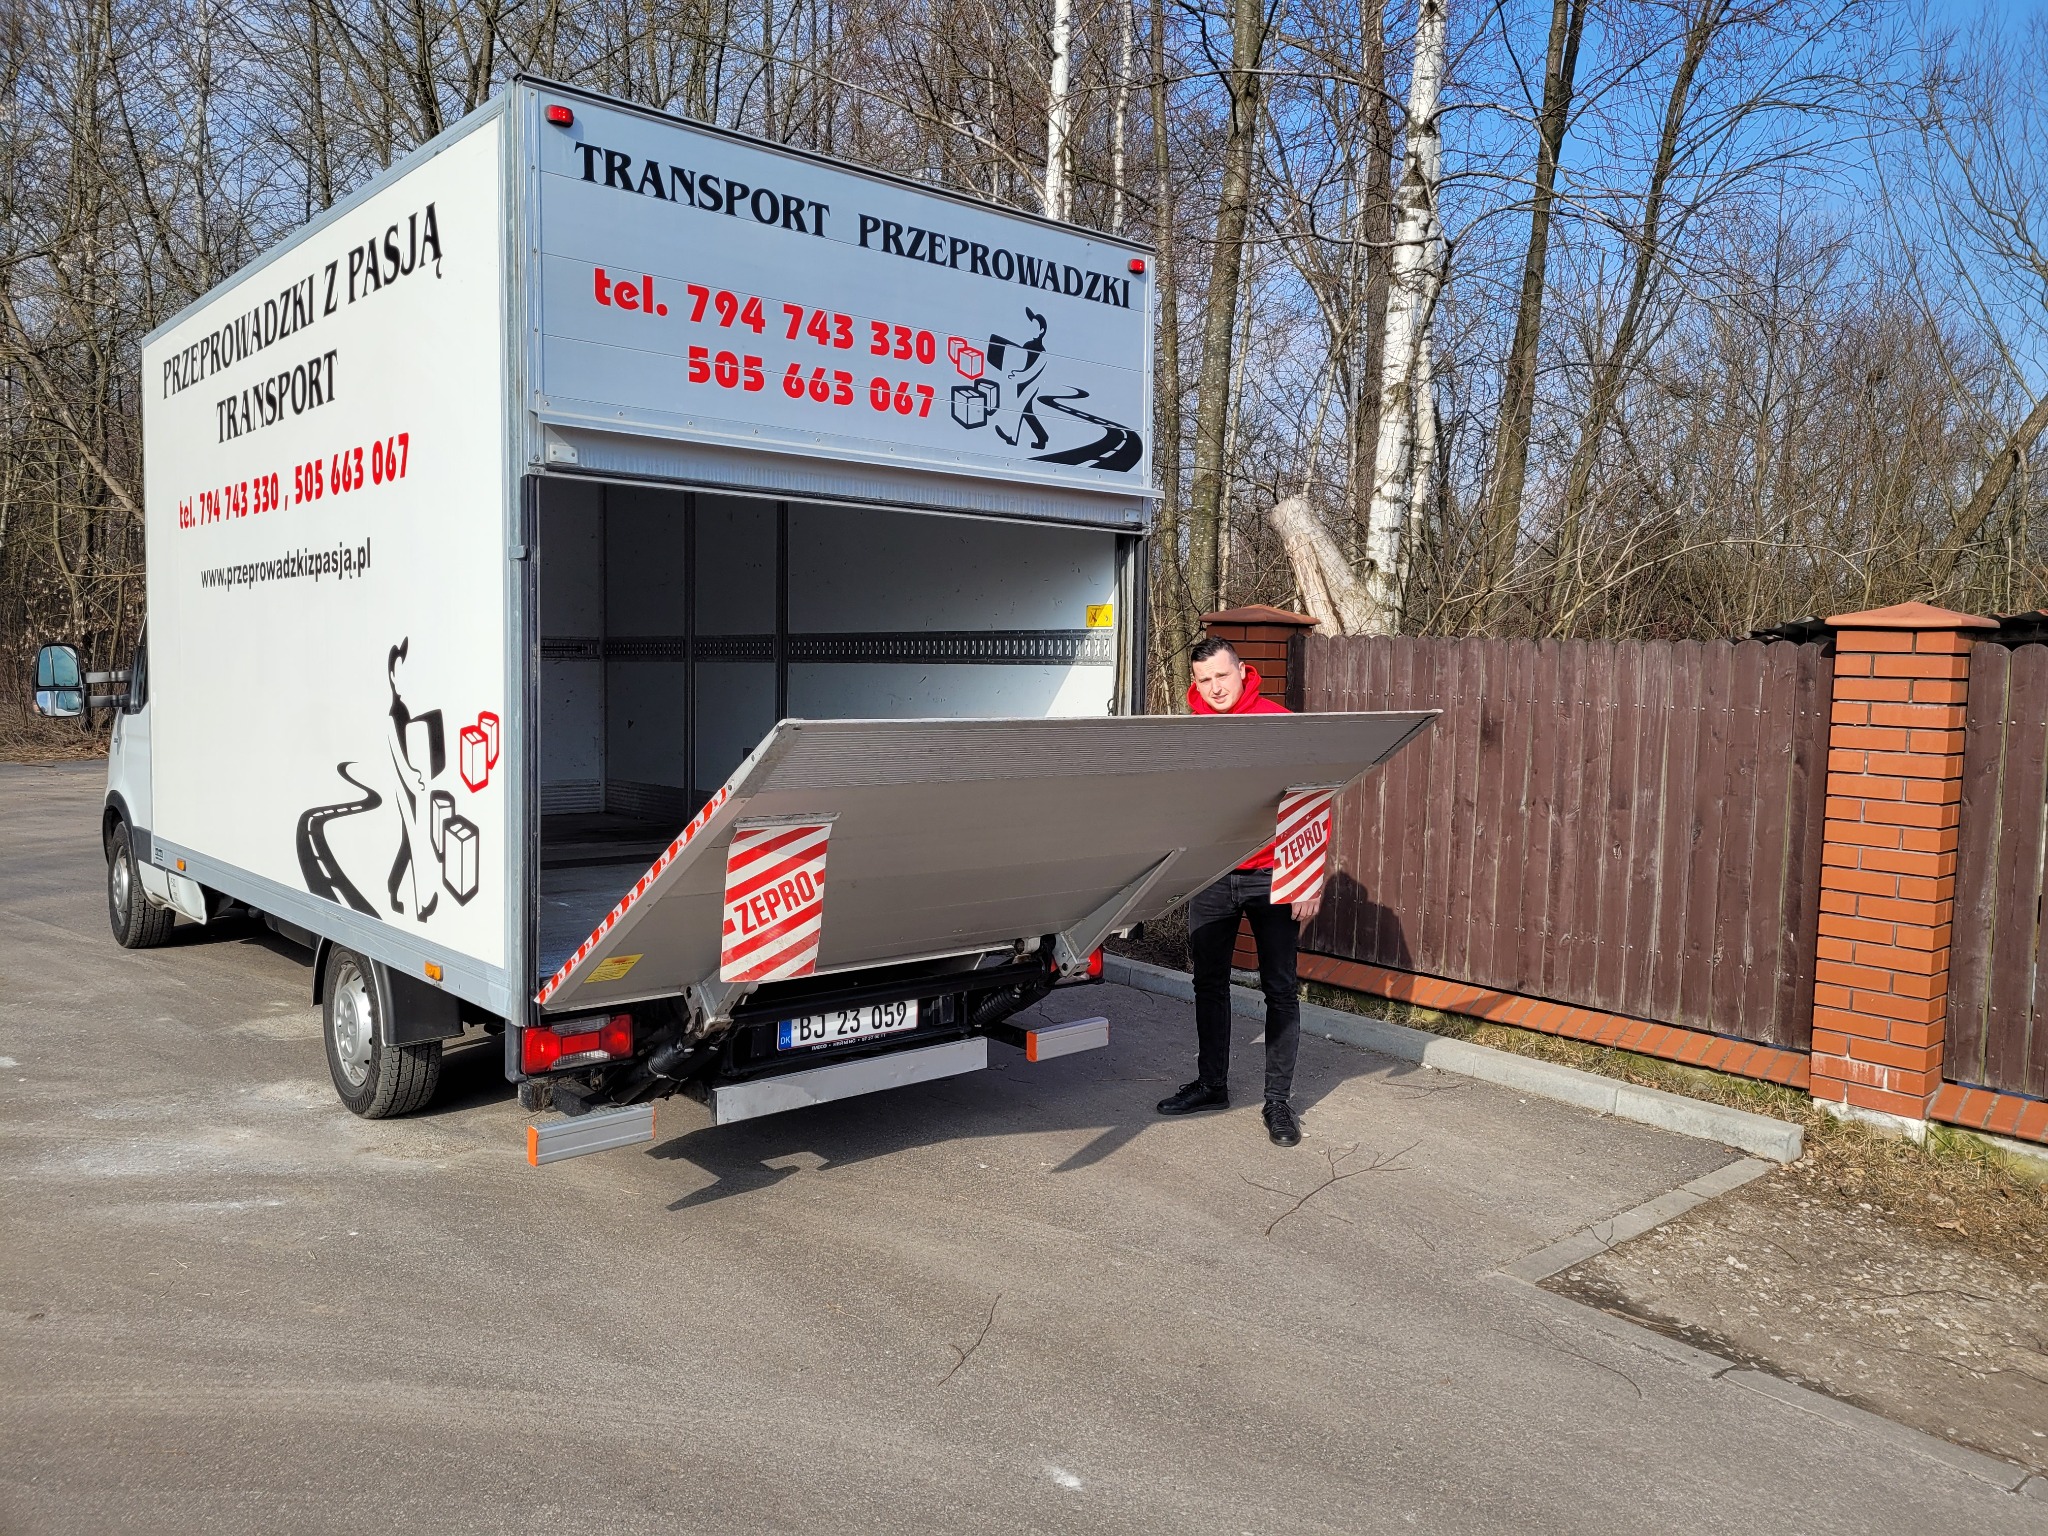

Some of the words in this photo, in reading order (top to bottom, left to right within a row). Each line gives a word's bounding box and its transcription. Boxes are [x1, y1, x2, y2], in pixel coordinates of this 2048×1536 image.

[574, 141, 831, 238] TRANSPORT
[858, 213, 1131, 309] PRZEPROWADZKI
[163, 273, 315, 400] PRZEPROWADZKI
[323, 259, 339, 318] Z
[347, 201, 443, 305] PASJĄ
[594, 267, 668, 317] tel.
[687, 284, 766, 334] 794
[783, 303, 854, 350] 743
[870, 321, 936, 365] 330
[216, 348, 339, 444] TRANSPORT
[688, 346, 765, 392] 505
[783, 362, 854, 406] 663
[870, 377, 935, 418] 067
[179, 495, 197, 530] tel.
[199, 489, 221, 526] 794
[225, 480, 248, 521] 743
[253, 472, 279, 515] 330
[295, 458, 324, 505] 505
[330, 446, 364, 496] 663
[372, 432, 410, 485] 067
[200, 536, 372, 593] www.przeprowadzkizpasją.pl
[1280, 820, 1323, 870] ZEPRO
[733, 870, 816, 936] ZEPRO
[780, 1035, 791, 1045] DK
[799, 1014, 826, 1041] BJ
[837, 1008, 861, 1036] 23
[871, 1001, 907, 1030] 059
